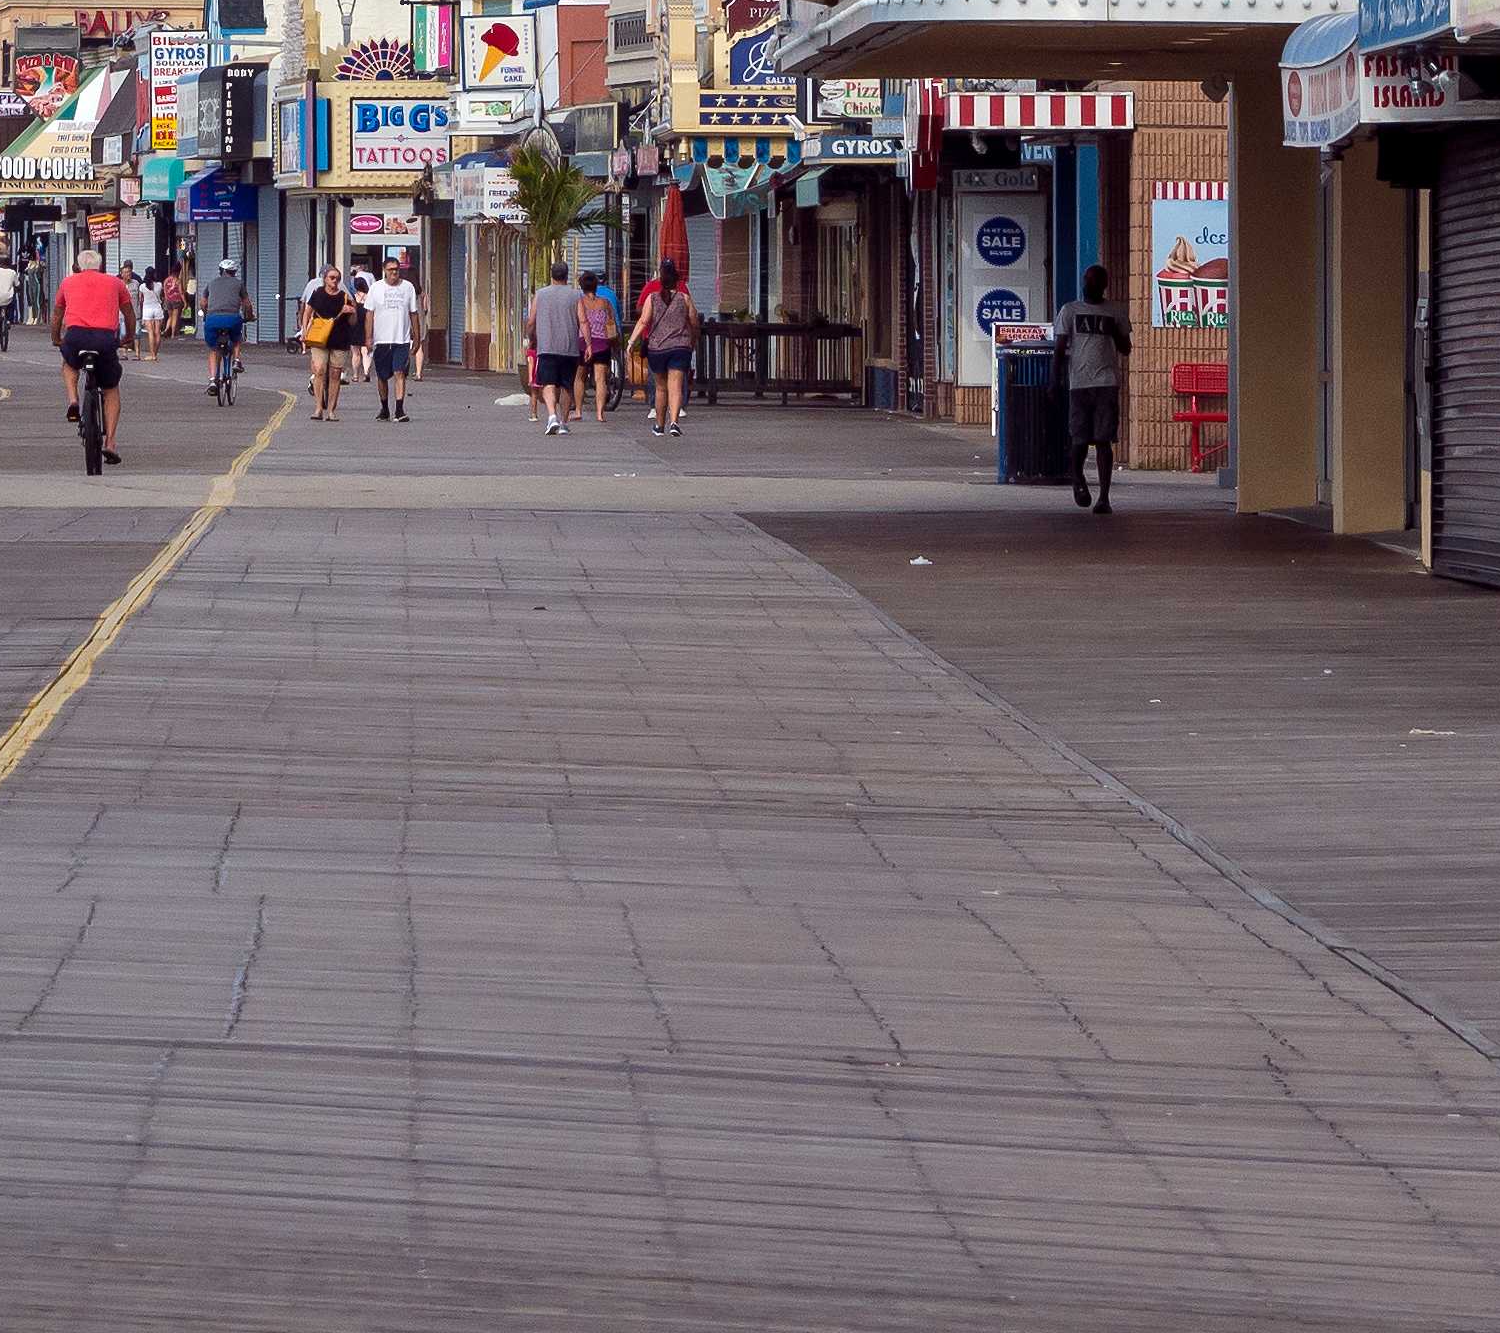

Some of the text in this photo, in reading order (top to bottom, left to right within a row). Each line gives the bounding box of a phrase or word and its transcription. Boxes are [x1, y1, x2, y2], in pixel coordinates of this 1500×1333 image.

[154, 47, 206, 60] GYROS
[765, 76, 781, 85] SALT
[354, 103, 449, 133] BIG G'S
[831, 139, 893, 155] GYROS
[355, 147, 448, 164] TATTOOS
[995, 171, 1036, 188] Gold
[981, 235, 1022, 248] SALE
[981, 307, 1022, 321] SALE
